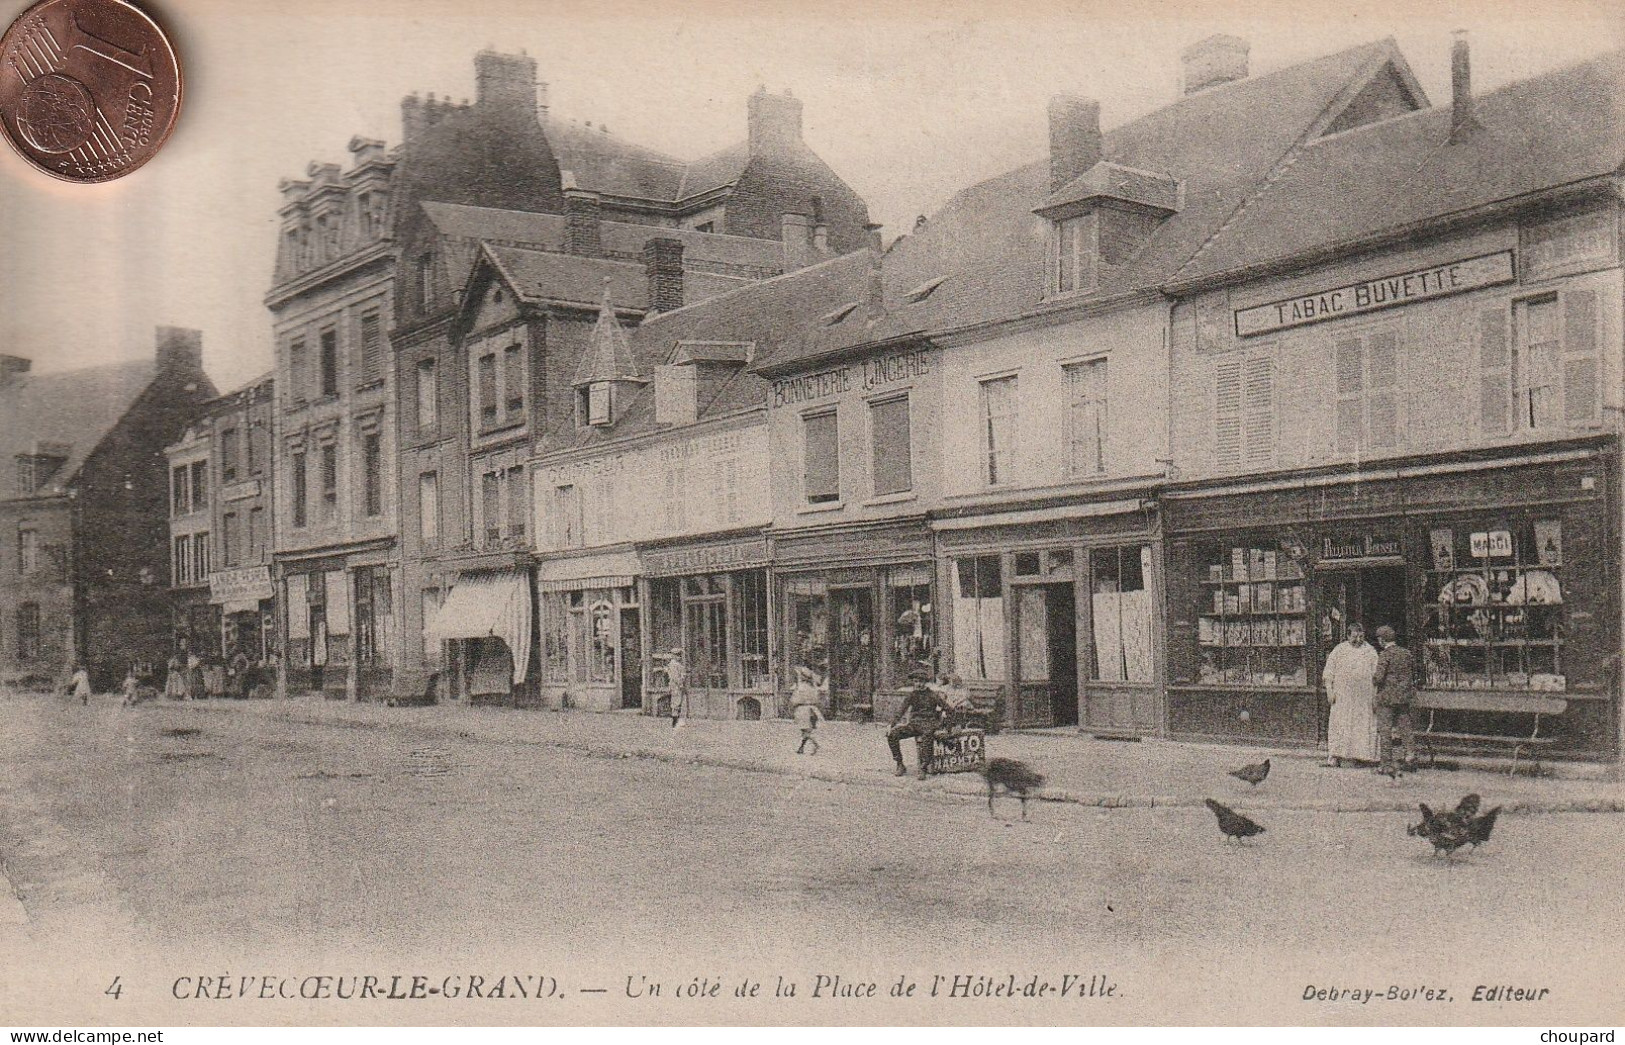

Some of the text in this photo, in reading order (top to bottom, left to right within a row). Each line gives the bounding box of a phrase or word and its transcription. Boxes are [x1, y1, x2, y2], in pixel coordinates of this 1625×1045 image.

[68, 10, 154, 79] 1
[121, 82, 153, 149] CENT
[1273, 266, 1462, 324] TABAC BUVETTE
[772, 351, 930, 409] BONNETERIE LINGERIE
